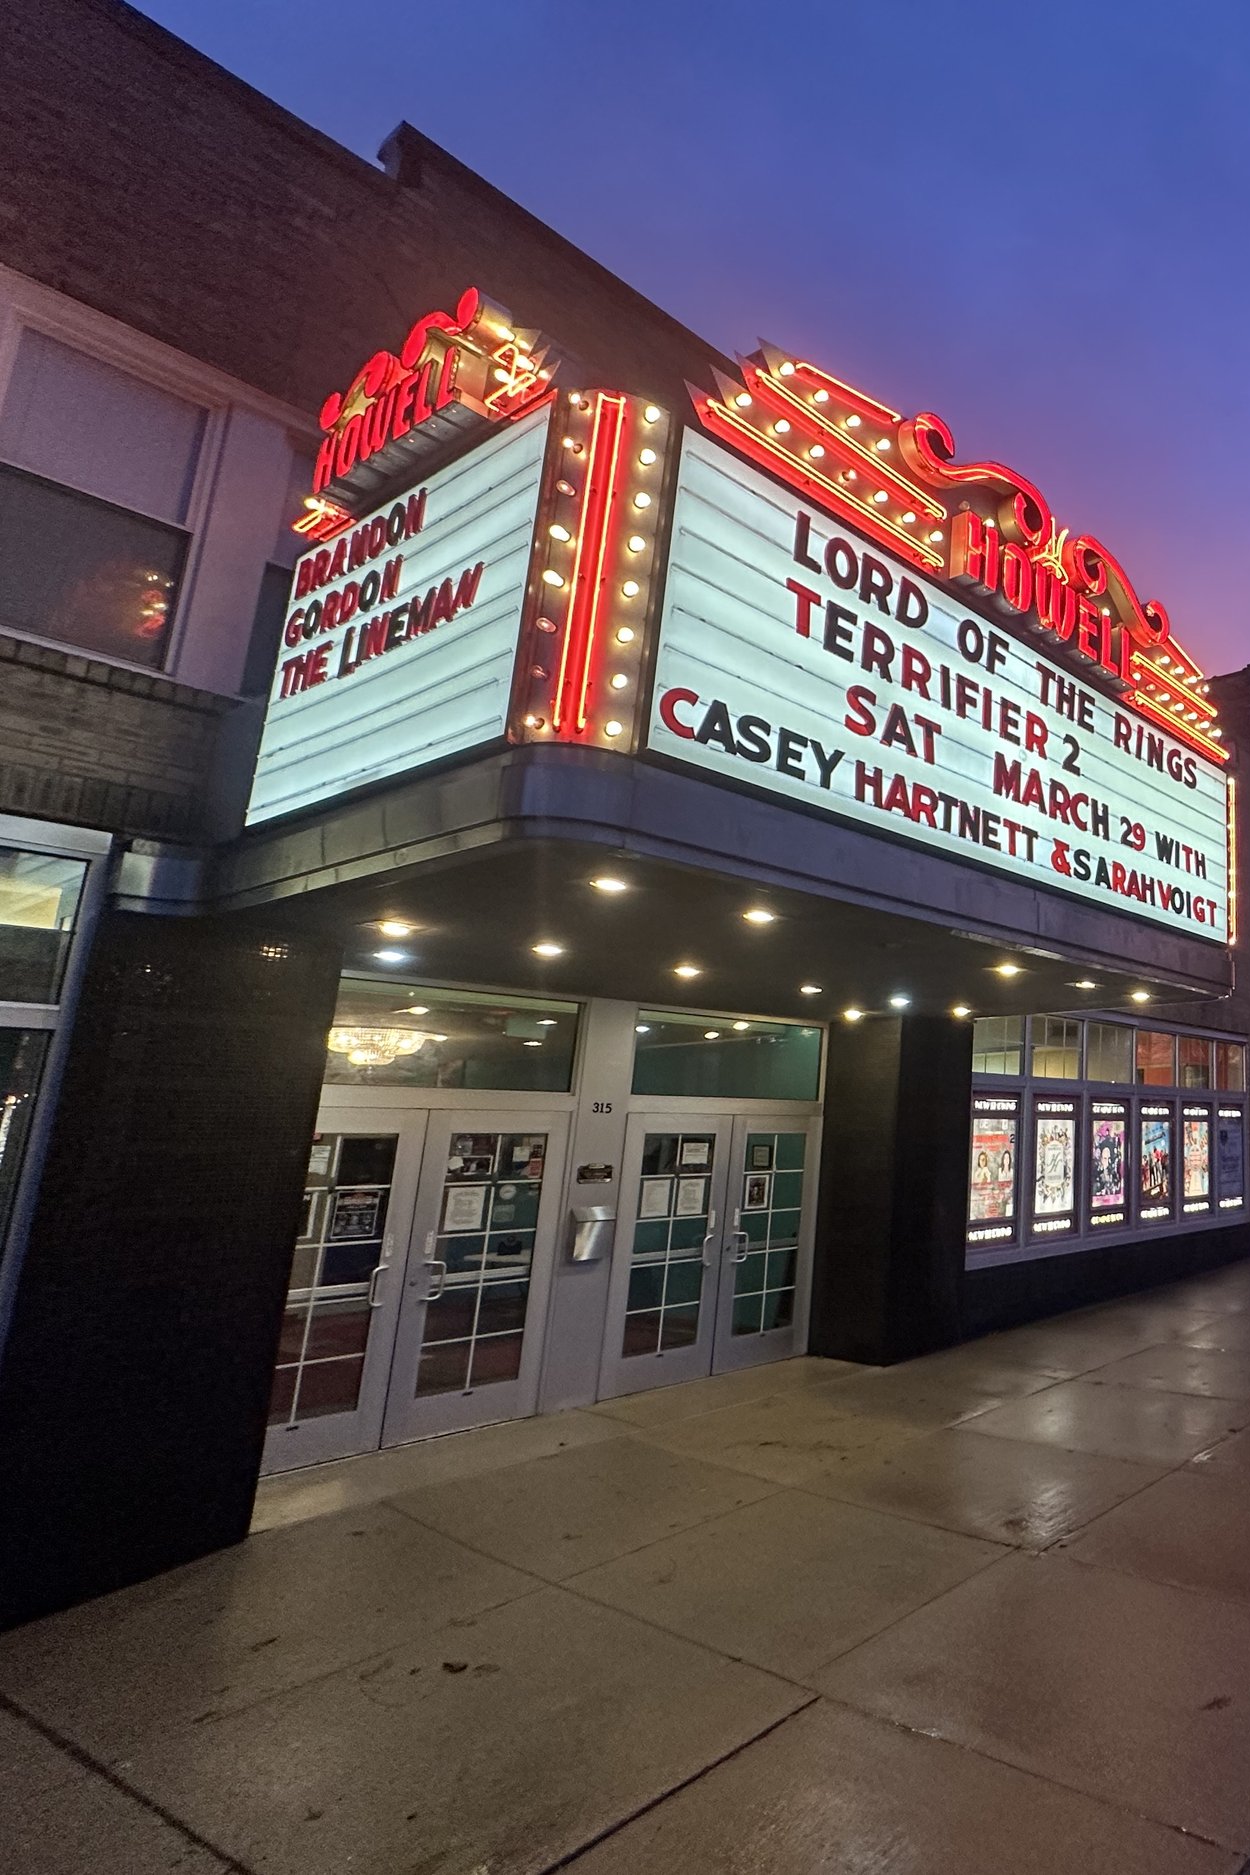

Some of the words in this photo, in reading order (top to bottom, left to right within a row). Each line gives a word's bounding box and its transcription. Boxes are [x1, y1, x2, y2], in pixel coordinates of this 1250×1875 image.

[313, 346, 461, 493] HOWELL
[284, 554, 404, 648] GORDON
[295, 487, 428, 600] BRANDON
[960, 511, 1137, 690] HOWELL
[278, 640, 334, 699] THE
[338, 561, 486, 679] LINEMAN
[786, 577, 1049, 760] TERRIFIER
[1062, 734, 1081, 776] 2
[793, 510, 929, 628] LORD
[957, 619, 1009, 675] OF
[1036, 661, 1095, 733] THE
[1114, 711, 1198, 789] RINGS
[659, 687, 845, 790] CASEY
[855, 759, 1039, 863] HARTNETT
[1154, 879, 1217, 927] VOIGT
[844, 685, 942, 765] SAT
[993, 751, 1110, 841] MARCH
[1120, 816, 1146, 852] 29
[1155, 831, 1207, 880] WITH
[592, 1102, 612, 1114] 315
